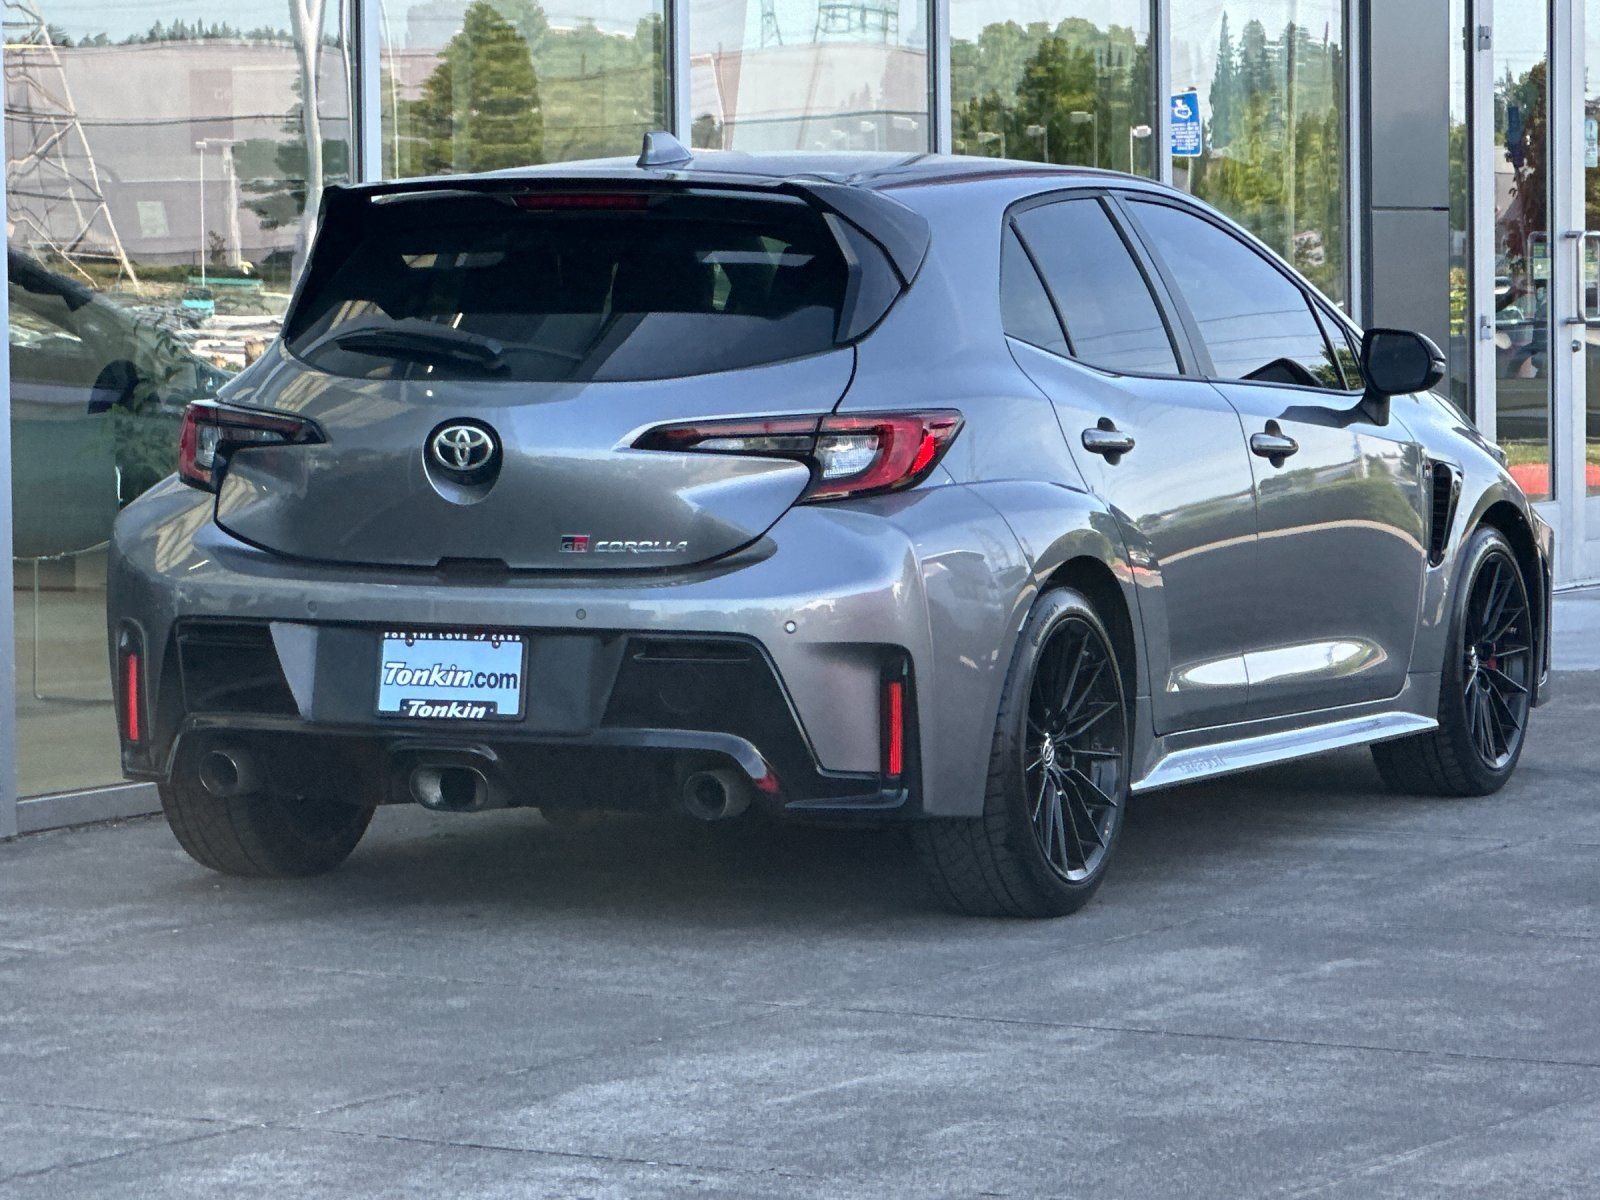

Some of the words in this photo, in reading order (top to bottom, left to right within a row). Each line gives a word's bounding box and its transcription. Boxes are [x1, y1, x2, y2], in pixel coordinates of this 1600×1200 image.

[594, 541, 688, 553] COROLLA
[384, 631, 406, 639] FOR
[384, 661, 518, 690] Tonkin.com
[408, 700, 487, 719] Tonkin
